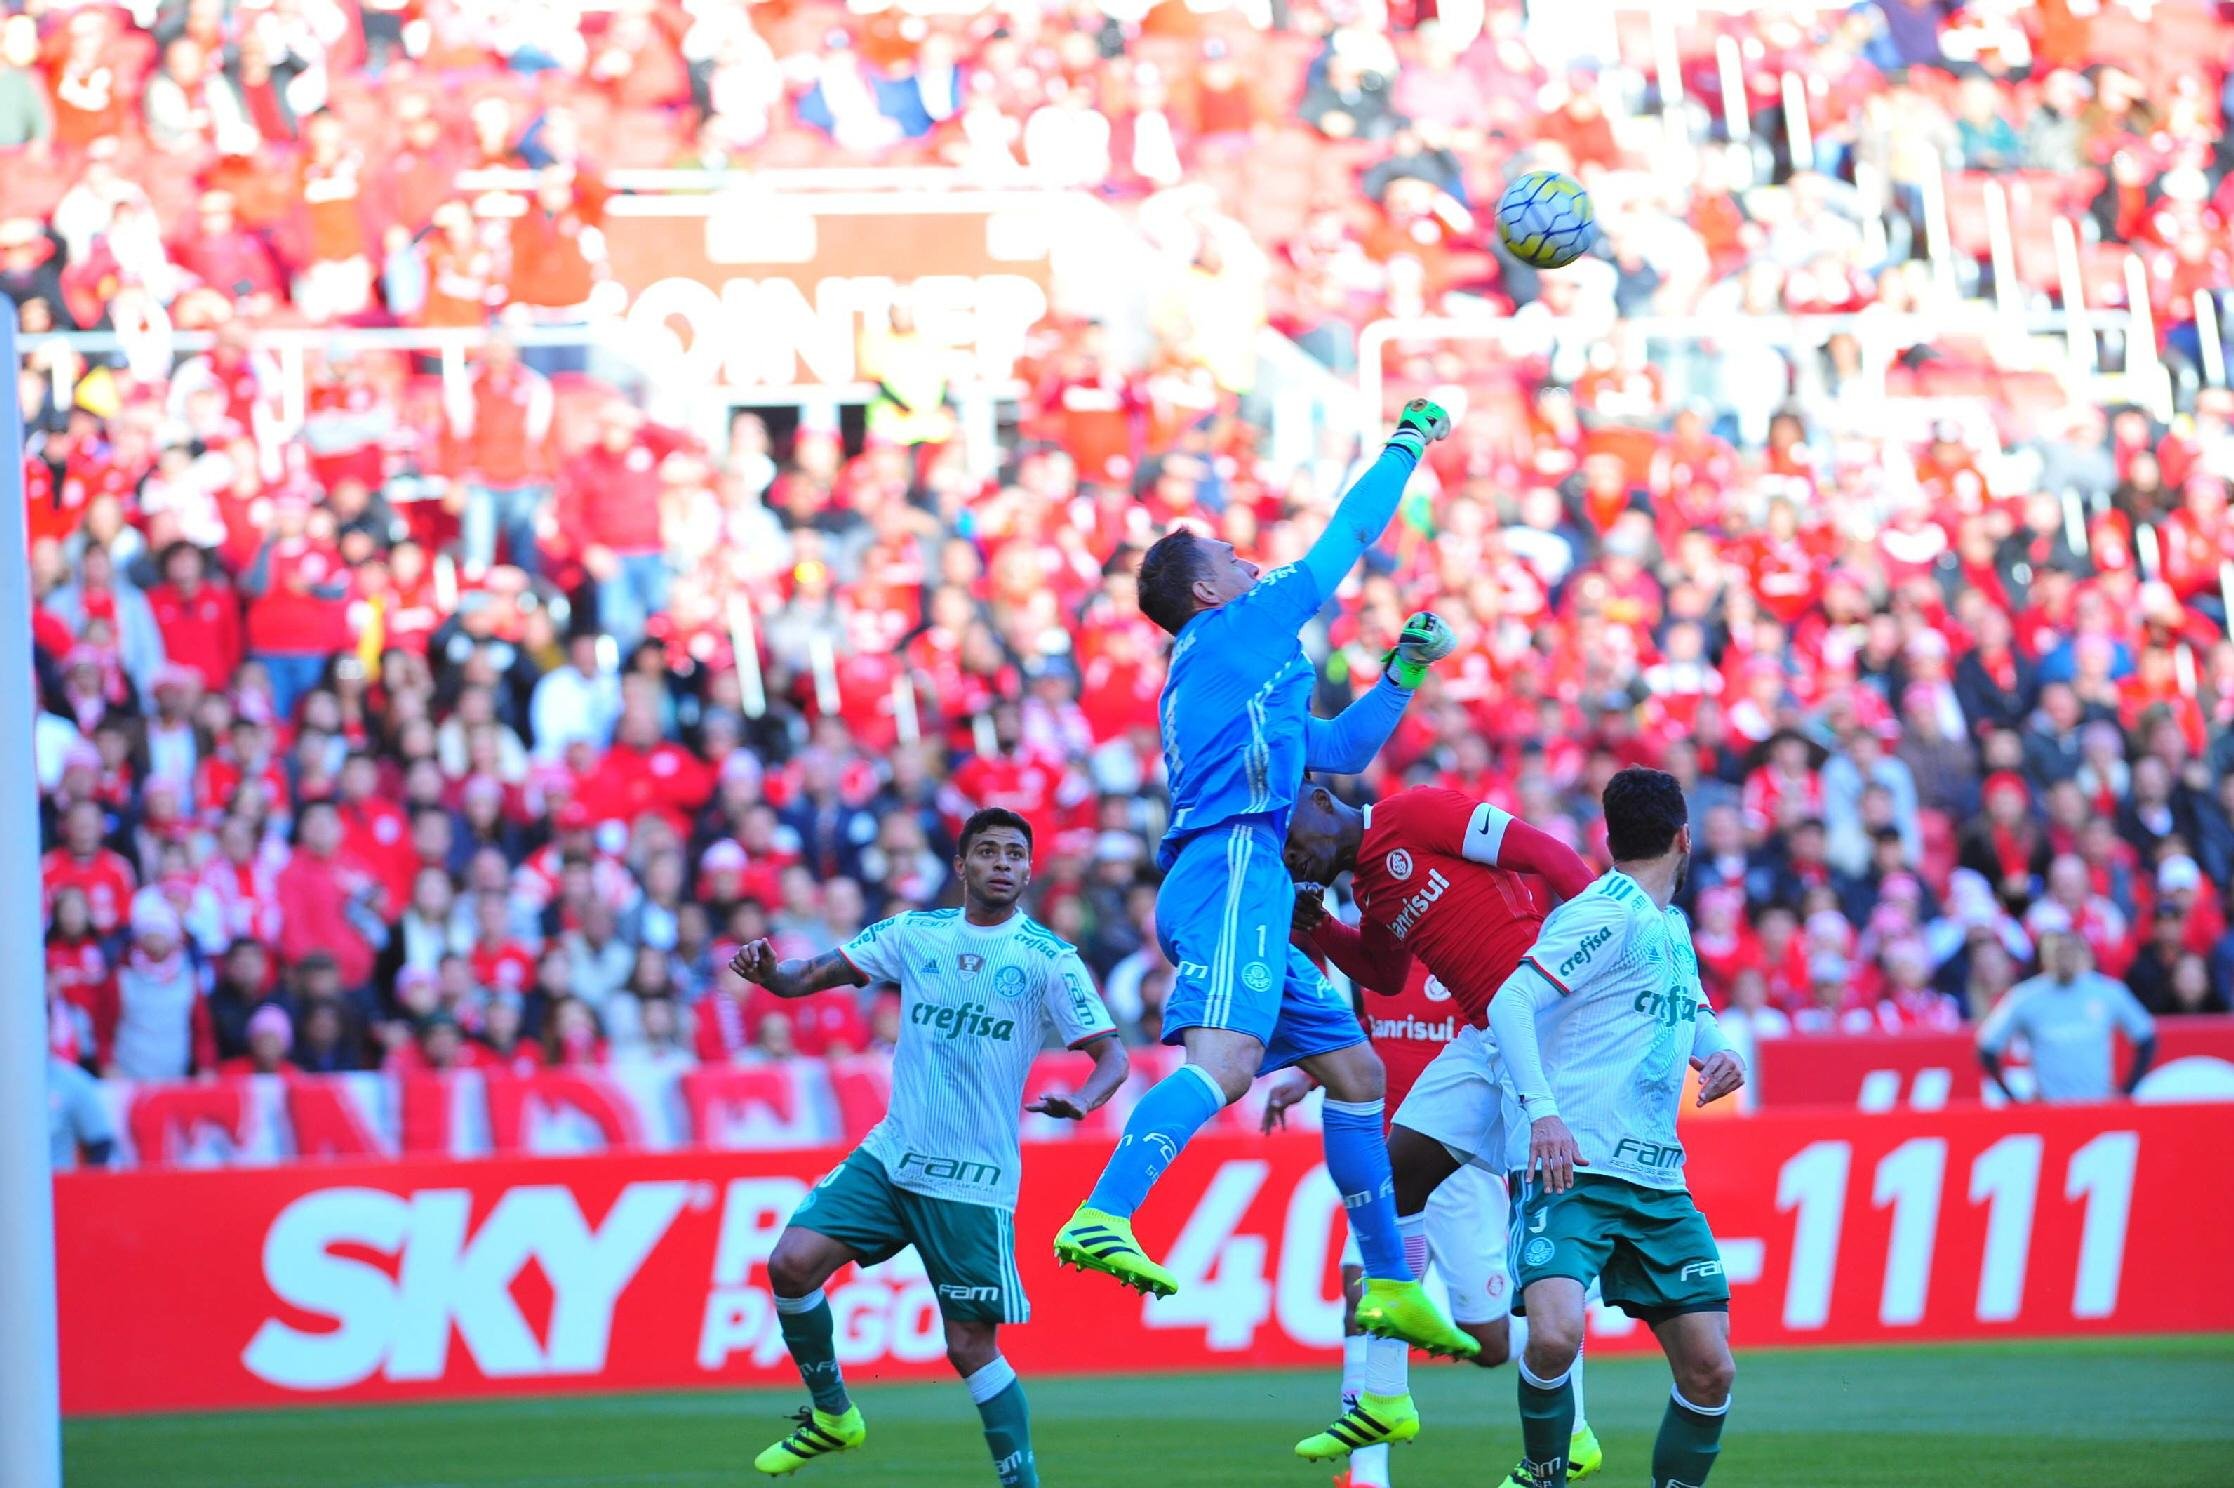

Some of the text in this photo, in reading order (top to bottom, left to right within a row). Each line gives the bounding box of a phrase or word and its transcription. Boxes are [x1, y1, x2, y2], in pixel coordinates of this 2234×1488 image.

[1386, 867, 1451, 941] anrisul
[1014, 932, 1057, 960] crefisa
[1255, 925, 1267, 957] 1
[1560, 925, 1612, 977] crefisa
[911, 1001, 1015, 1041] crefisa
[1368, 1013, 1455, 1042] anrisul
[239, 1180, 692, 1391] SKY
